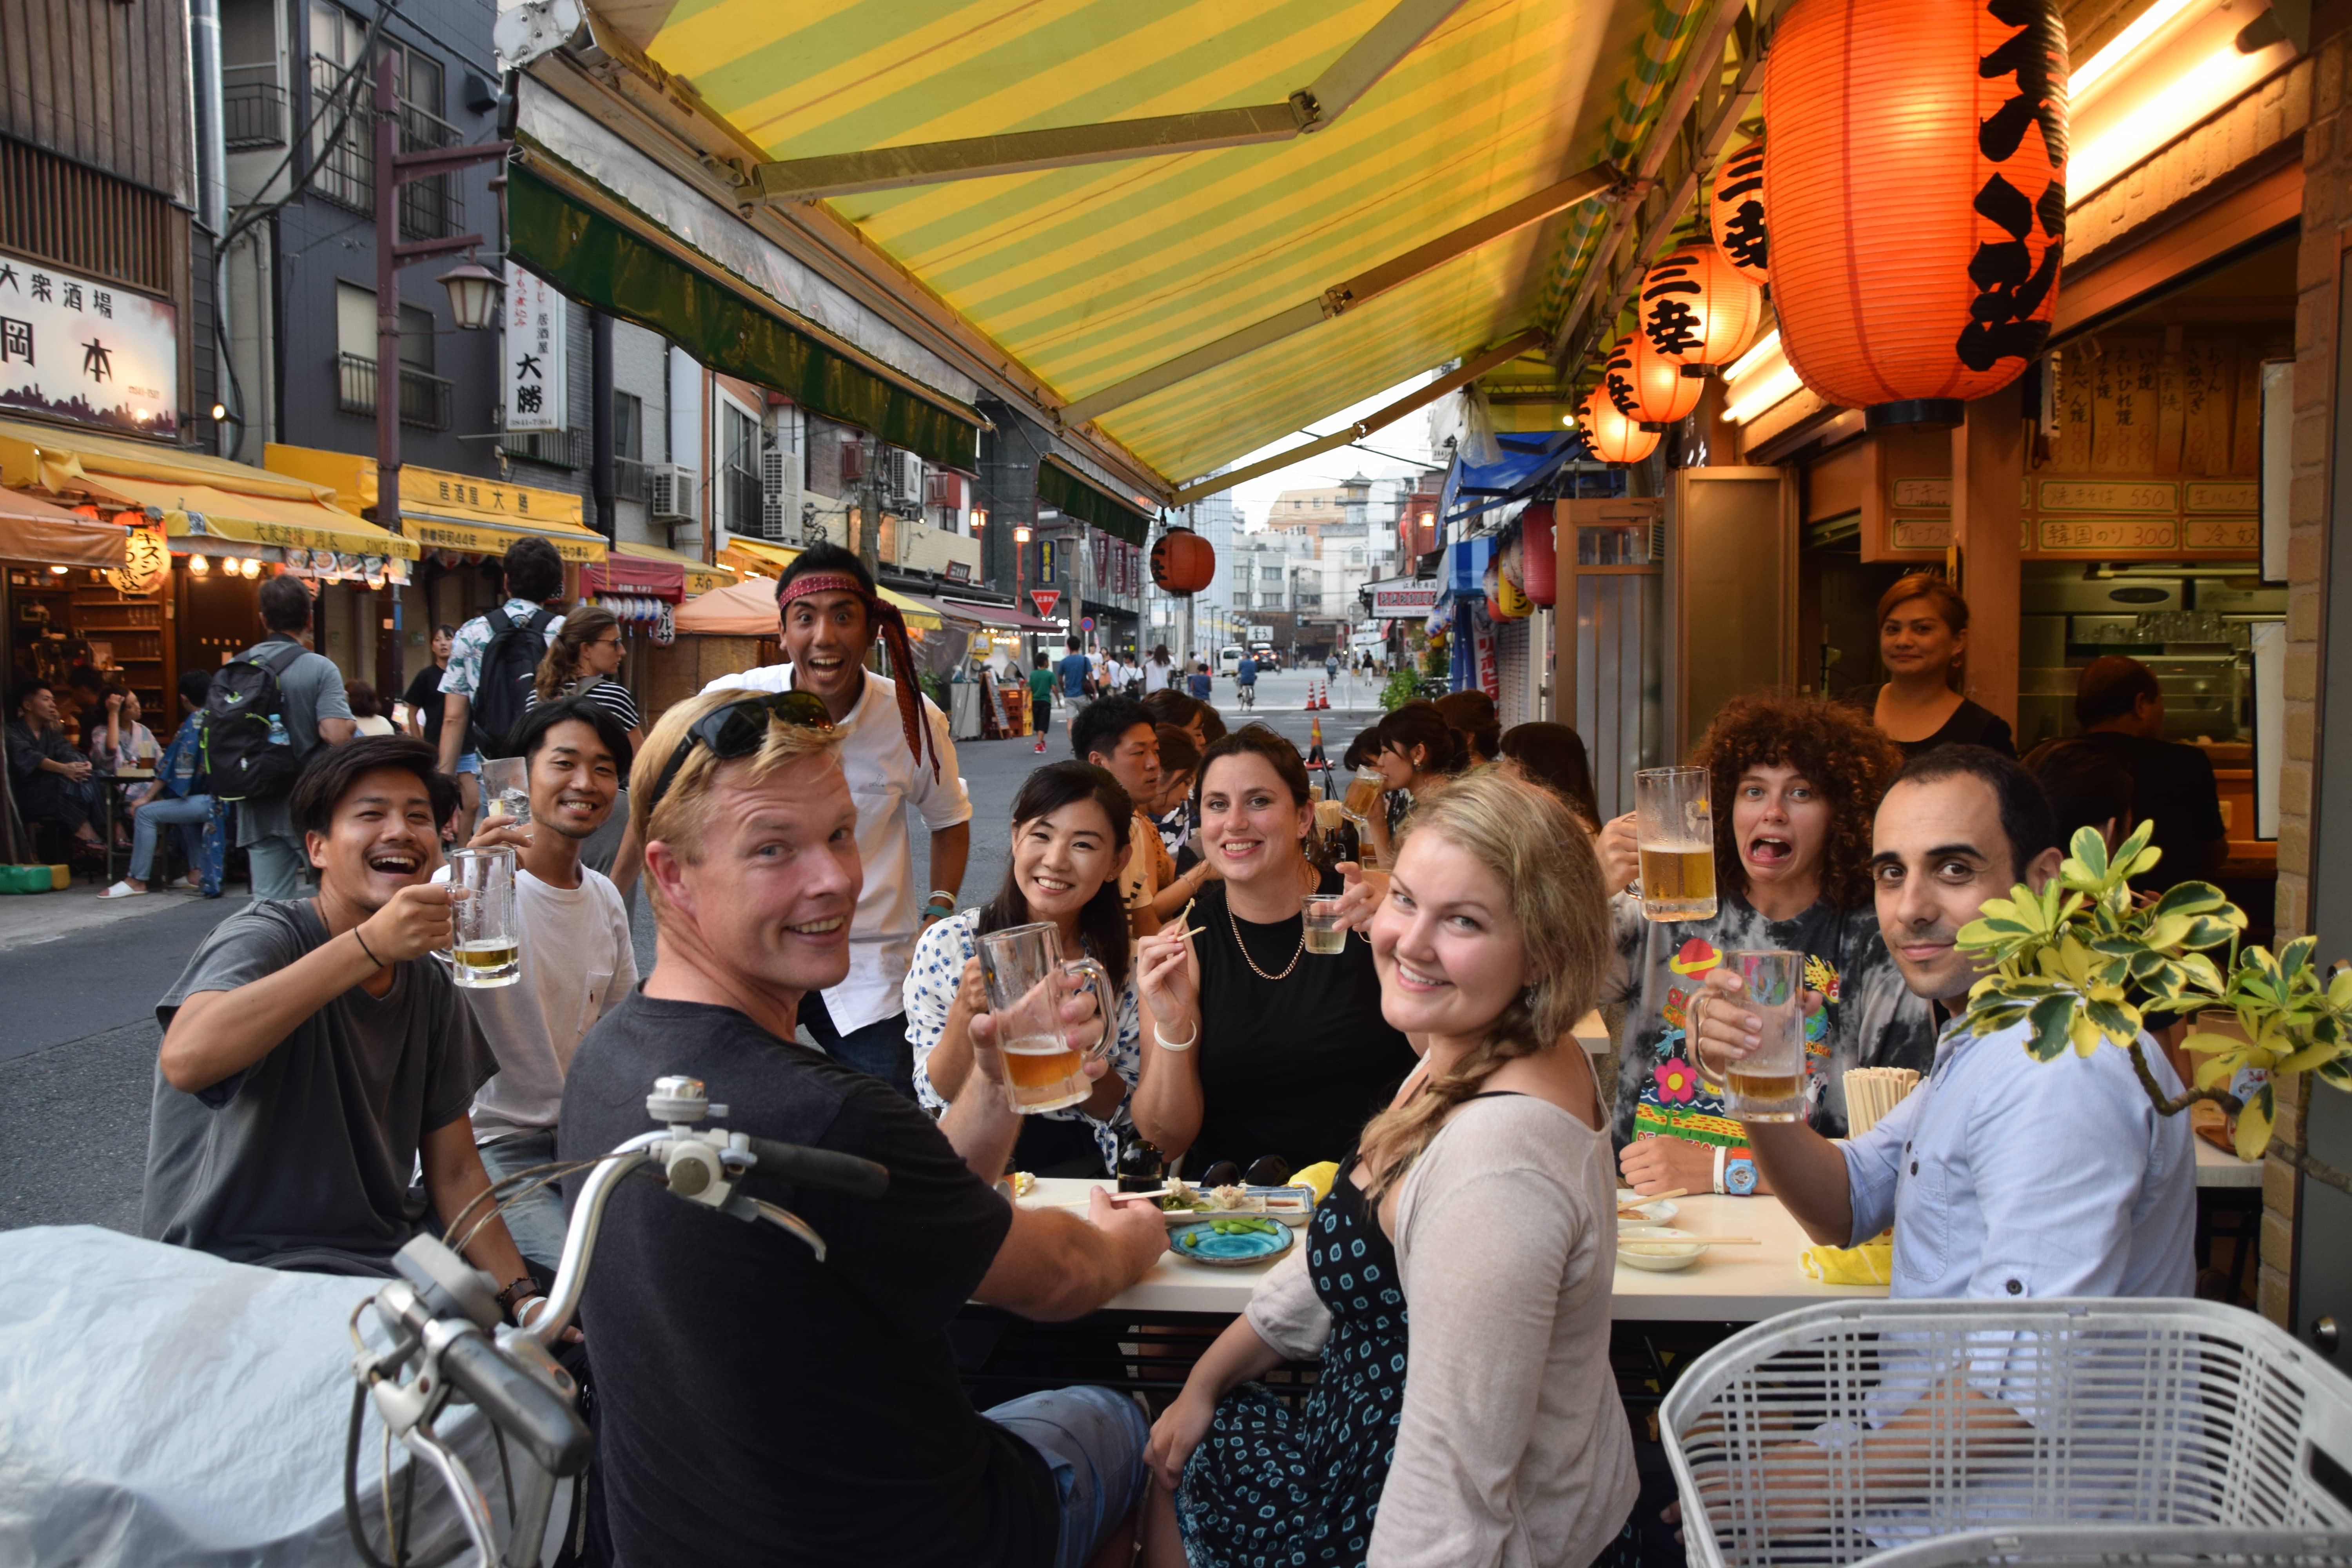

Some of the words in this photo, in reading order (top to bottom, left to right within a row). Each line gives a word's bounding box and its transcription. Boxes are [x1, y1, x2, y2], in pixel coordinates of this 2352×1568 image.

[0, 263, 112, 319] 大衆酒場
[0, 316, 113, 384] 岡本
[439, 481, 479, 506] 居酒屋
[2049, 486, 2117, 506] 焼きそば
[2130, 488, 2165, 507] 550
[2047, 524, 2125, 546] 韓国のり
[2132, 525, 2172, 546] 300
[2204, 523, 2258, 545] 冷奴
